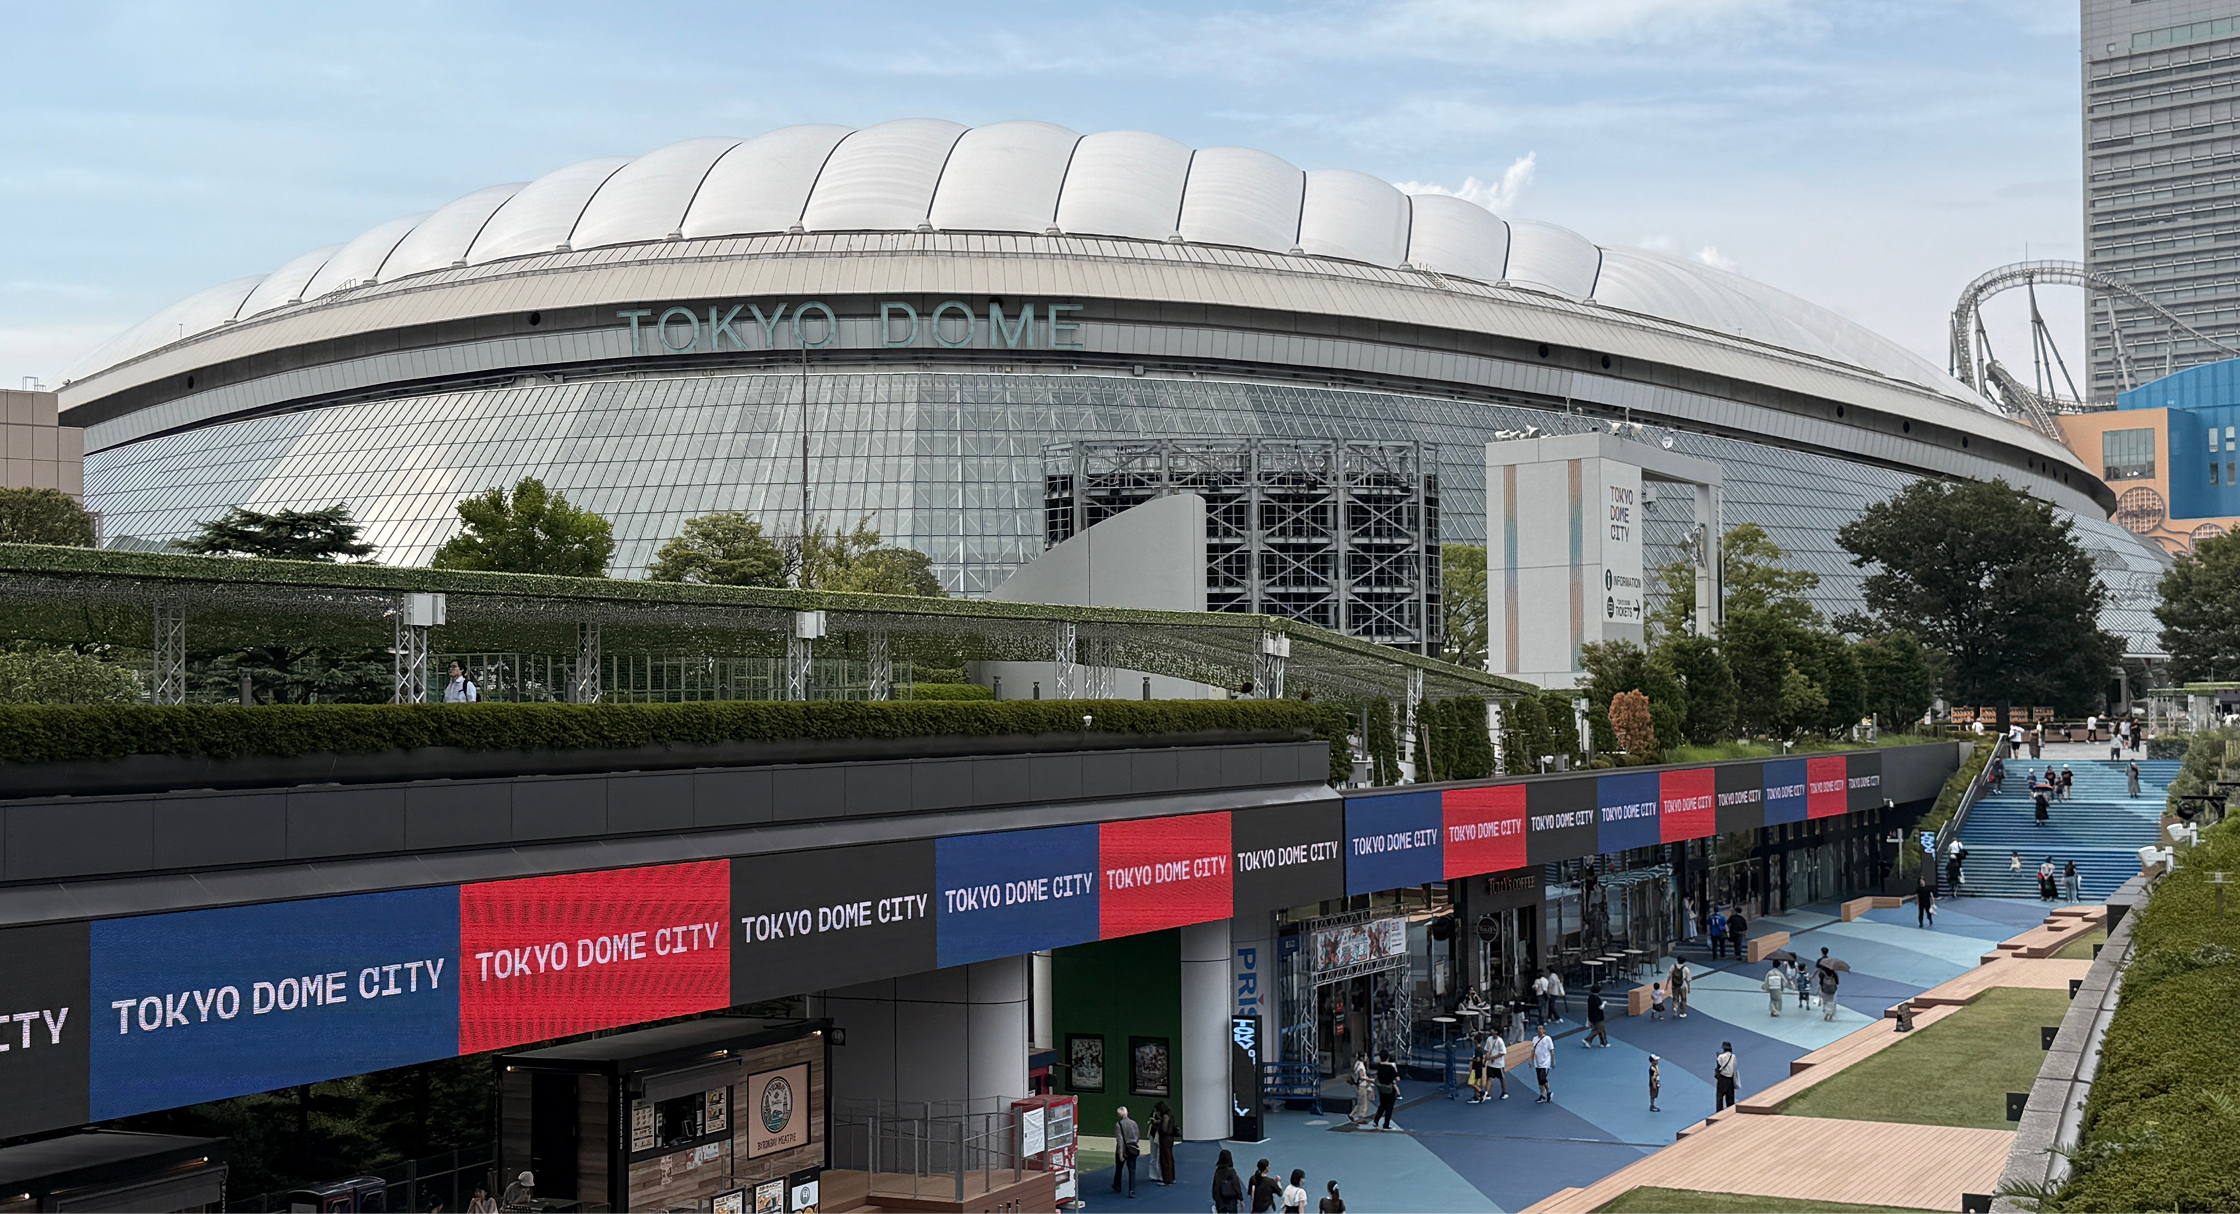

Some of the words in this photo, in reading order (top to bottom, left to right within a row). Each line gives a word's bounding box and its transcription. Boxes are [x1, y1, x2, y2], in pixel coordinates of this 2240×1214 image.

[616, 302, 837, 355] TOKYO
[880, 299, 1084, 351] DOME
[1609, 485, 1634, 505] TOKYO
[1609, 504, 1630, 523] DOME
[1610, 524, 1630, 542] CITY
[1613, 575, 1642, 589] INFORMATION
[1615, 606, 1633, 617] TICKETS
[1602, 806, 1623, 822] TOKYO
[1623, 804, 1640, 820] DOME
[1640, 802, 1657, 817] CITY
[1663, 799, 1682, 814] TOKYO
[1682, 797, 1697, 812] DOME
[1697, 795, 1712, 810] CITY
[1448, 824, 1477, 843] TOKYO
[1477, 822, 1500, 839] DOME
[1500, 819, 1522, 836] CITY
[1530, 814, 1555, 832] TOKYO
[1555, 812, 1575, 829] DOME
[1575, 810, 1594, 826] CITY
[1353, 836, 1385, 856] TOKYO
[1387, 832, 1413, 852] DOME
[1414, 829, 1438, 848] CITY
[1237, 849, 1276, 872] TOKYO
[1278, 845, 1308, 866] DOME
[1310, 841, 1338, 862] CITY
[1106, 865, 1152, 890] TOKYO
[1155, 860, 1190, 884] DOME
[1194, 855, 1227, 878] CITY
[945, 885, 1001, 914] TOKYO
[1006, 879, 1048, 906] DOME
[1053, 872, 1093, 899] CITY
[1487, 876, 1513, 895] TULLY'S
[1512, 875, 1536, 892] COFFEE
[742, 909, 812, 943] TOKYO
[818, 901, 872, 932] DOME
[878, 893, 928, 924] CITY
[475, 941, 568, 982] TOKYO
[578, 931, 647, 968] DOME
[656, 921, 719, 956] CITY
[111, 985, 240, 1035] TOKYO
[253, 971, 347, 1015] DOME
[359, 957, 445, 999] CITY
